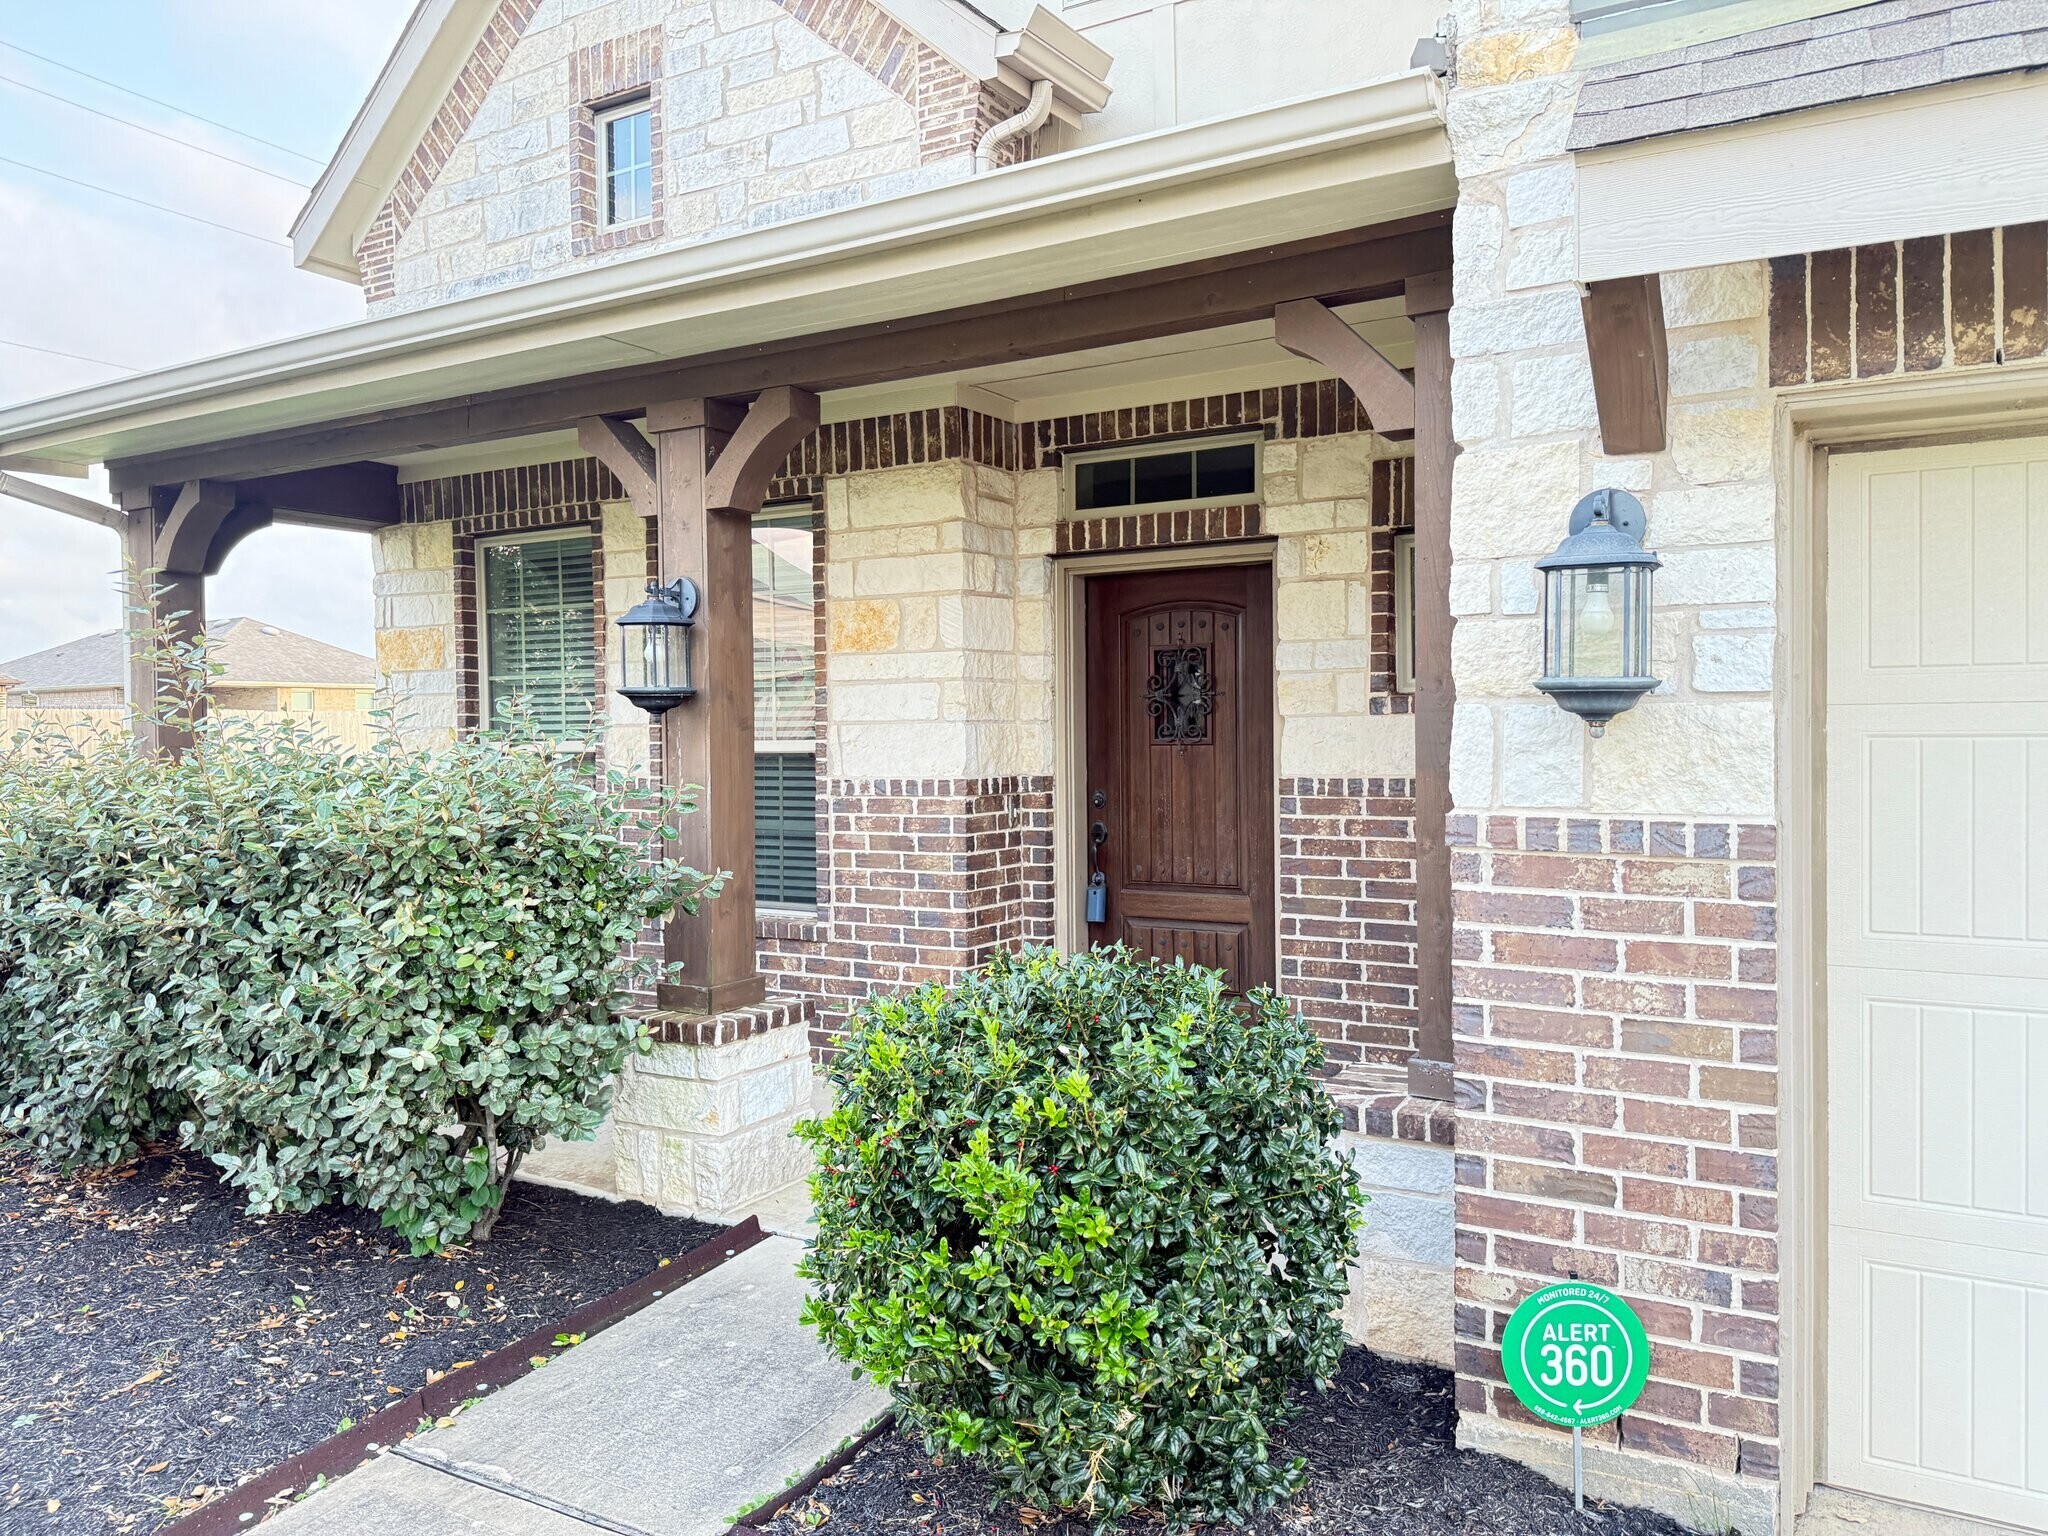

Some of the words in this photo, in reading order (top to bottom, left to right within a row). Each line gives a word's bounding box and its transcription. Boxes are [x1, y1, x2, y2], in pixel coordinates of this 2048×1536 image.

[1536, 1287, 1587, 1305] MONITORED
[1588, 1290, 1611, 1305] 24/7
[1542, 1322, 1611, 1342] ALERT
[1540, 1343, 1613, 1387] 360
